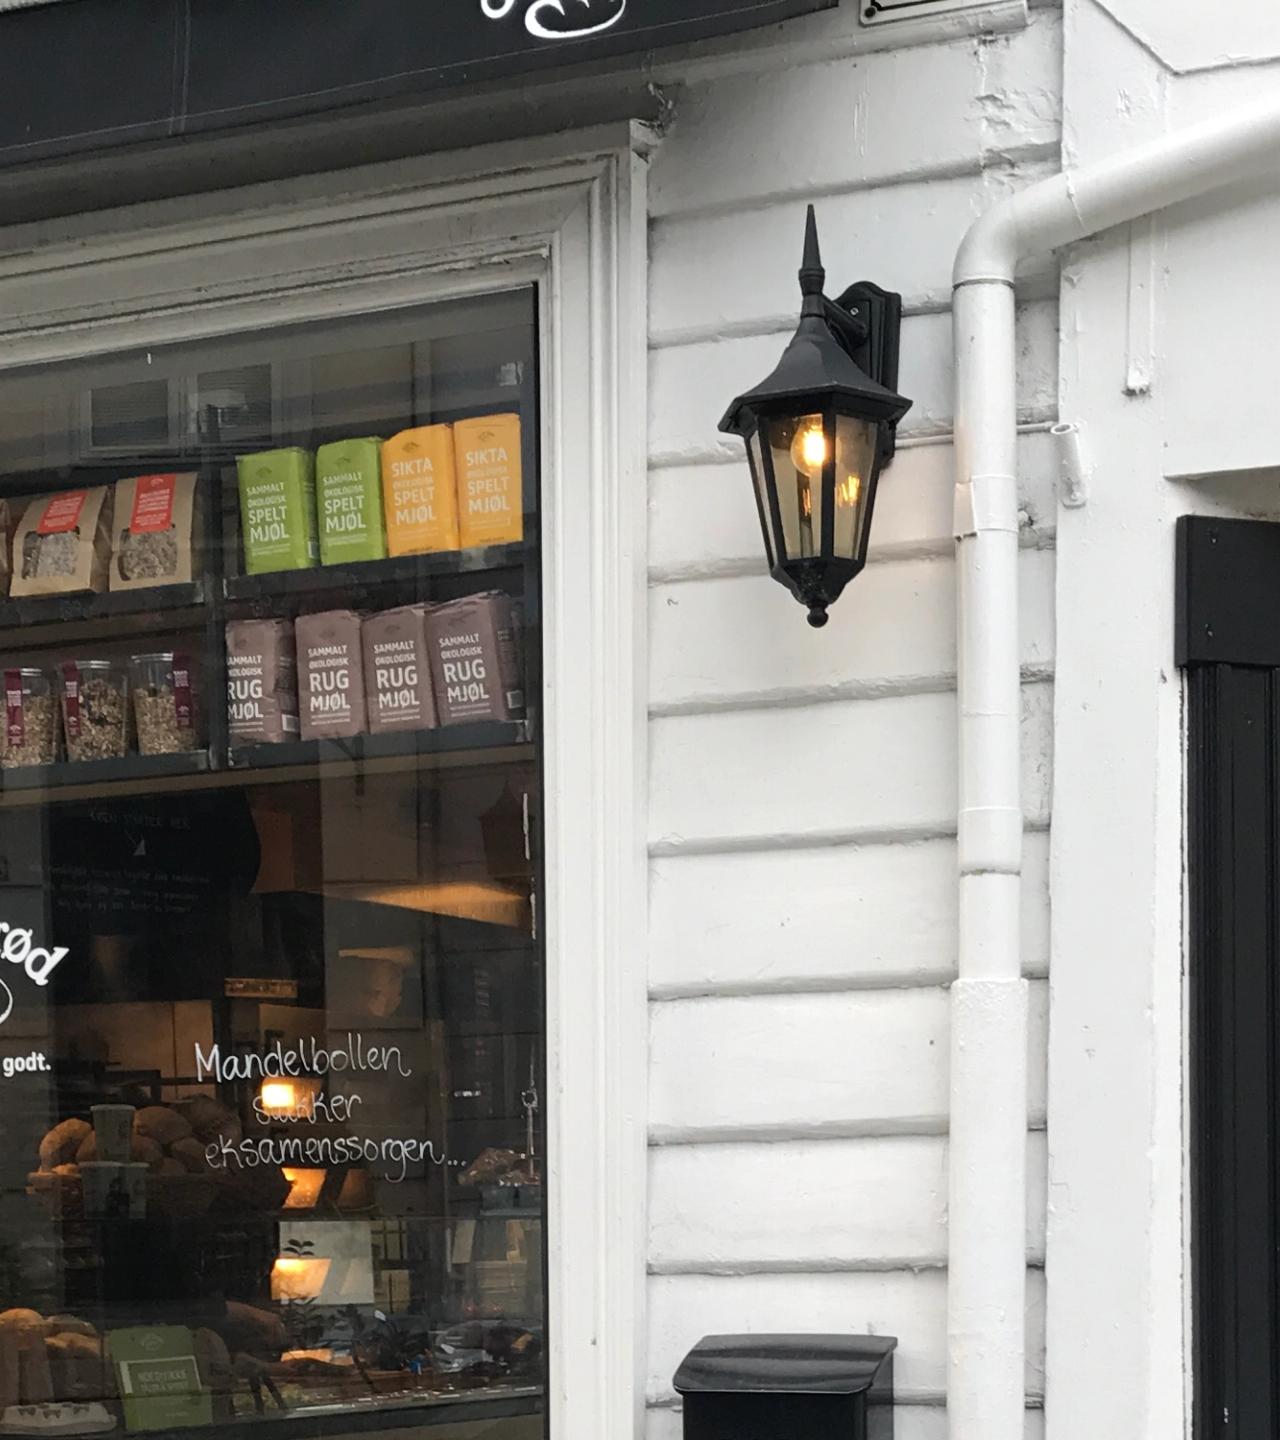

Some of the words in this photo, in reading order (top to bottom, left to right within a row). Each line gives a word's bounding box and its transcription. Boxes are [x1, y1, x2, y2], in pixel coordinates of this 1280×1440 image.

[465, 447, 508, 466] SIKTA
[391, 457, 433, 478] SIKTA
[394, 486, 435, 507] SPELT
[467, 476, 510, 496] SPELT
[248, 505, 287, 525] SPELT
[324, 495, 364, 515] SPELT
[250, 522, 290, 543] MJØL
[326, 511, 366, 533] MJØL
[374, 640, 414, 654] SAMMALT
[439, 633, 479, 648] SAMMALT
[227, 655, 262, 665] AMMALT
[308, 645, 347, 658] SAMMALT
[309, 669, 349, 693] RUG
[376, 665, 418, 689] RUG
[443, 659, 486, 683] RUG
[228, 679, 263, 700] RUG
[378, 689, 420, 709] MJØL
[448, 682, 489, 703] MJØL
[310, 691, 351, 712] MJØL
[3, 1051, 51, 1077] godt.
[194, 1032, 412, 1083] Mandelbollen
[205, 1135, 467, 1182] eksamenssorgen...
